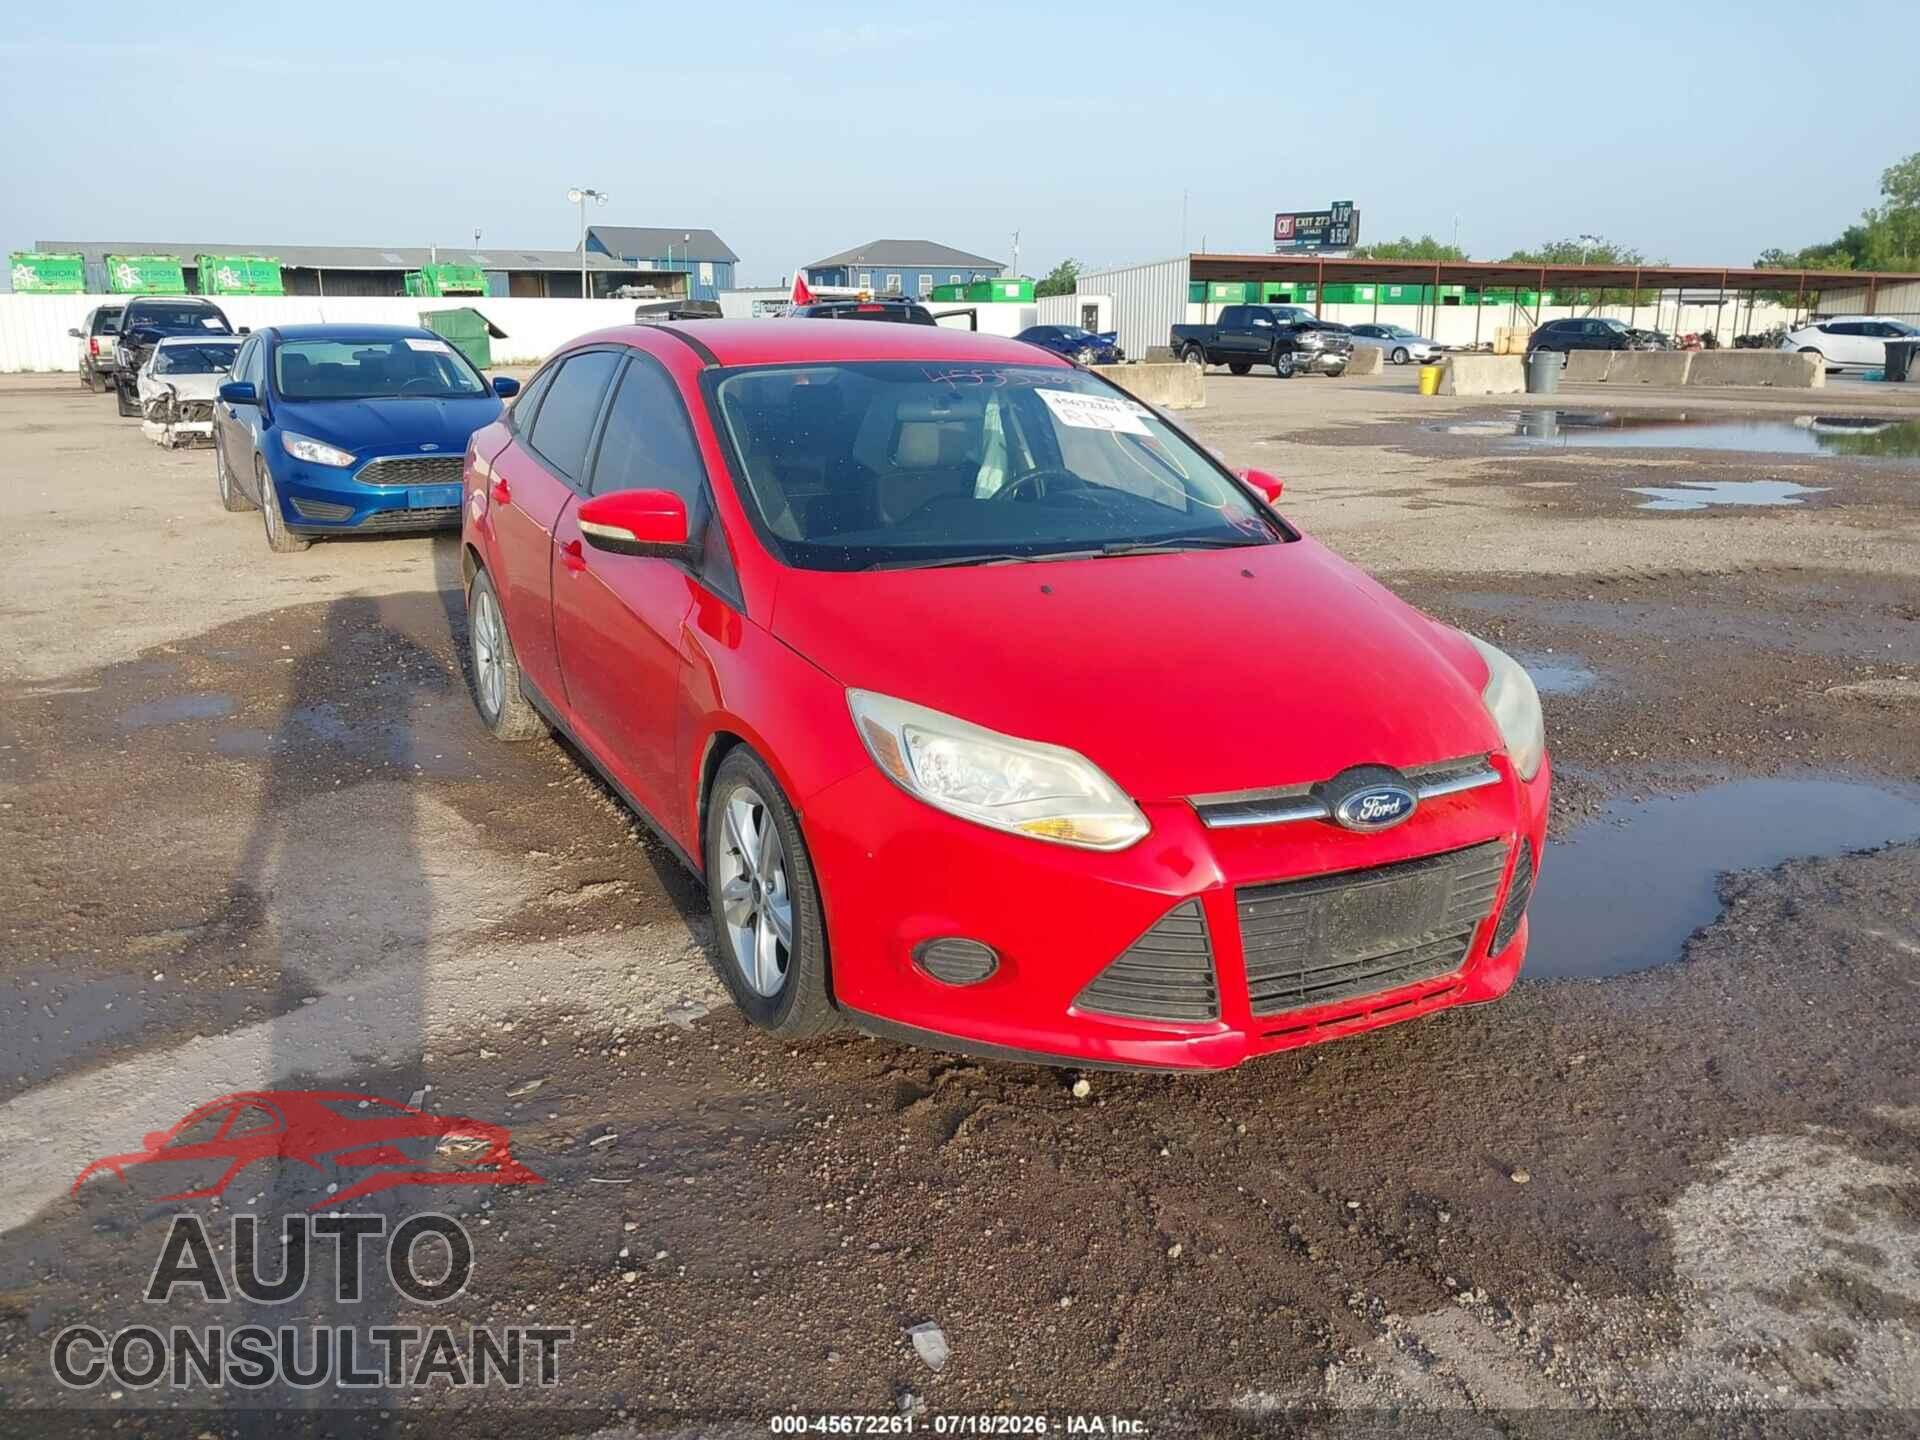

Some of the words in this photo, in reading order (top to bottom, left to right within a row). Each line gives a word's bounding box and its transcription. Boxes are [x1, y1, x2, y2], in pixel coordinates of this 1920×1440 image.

[1278, 220, 1292, 233] QT
[1296, 217, 1314, 227] EXIT
[1360, 794, 1401, 820] Ford
